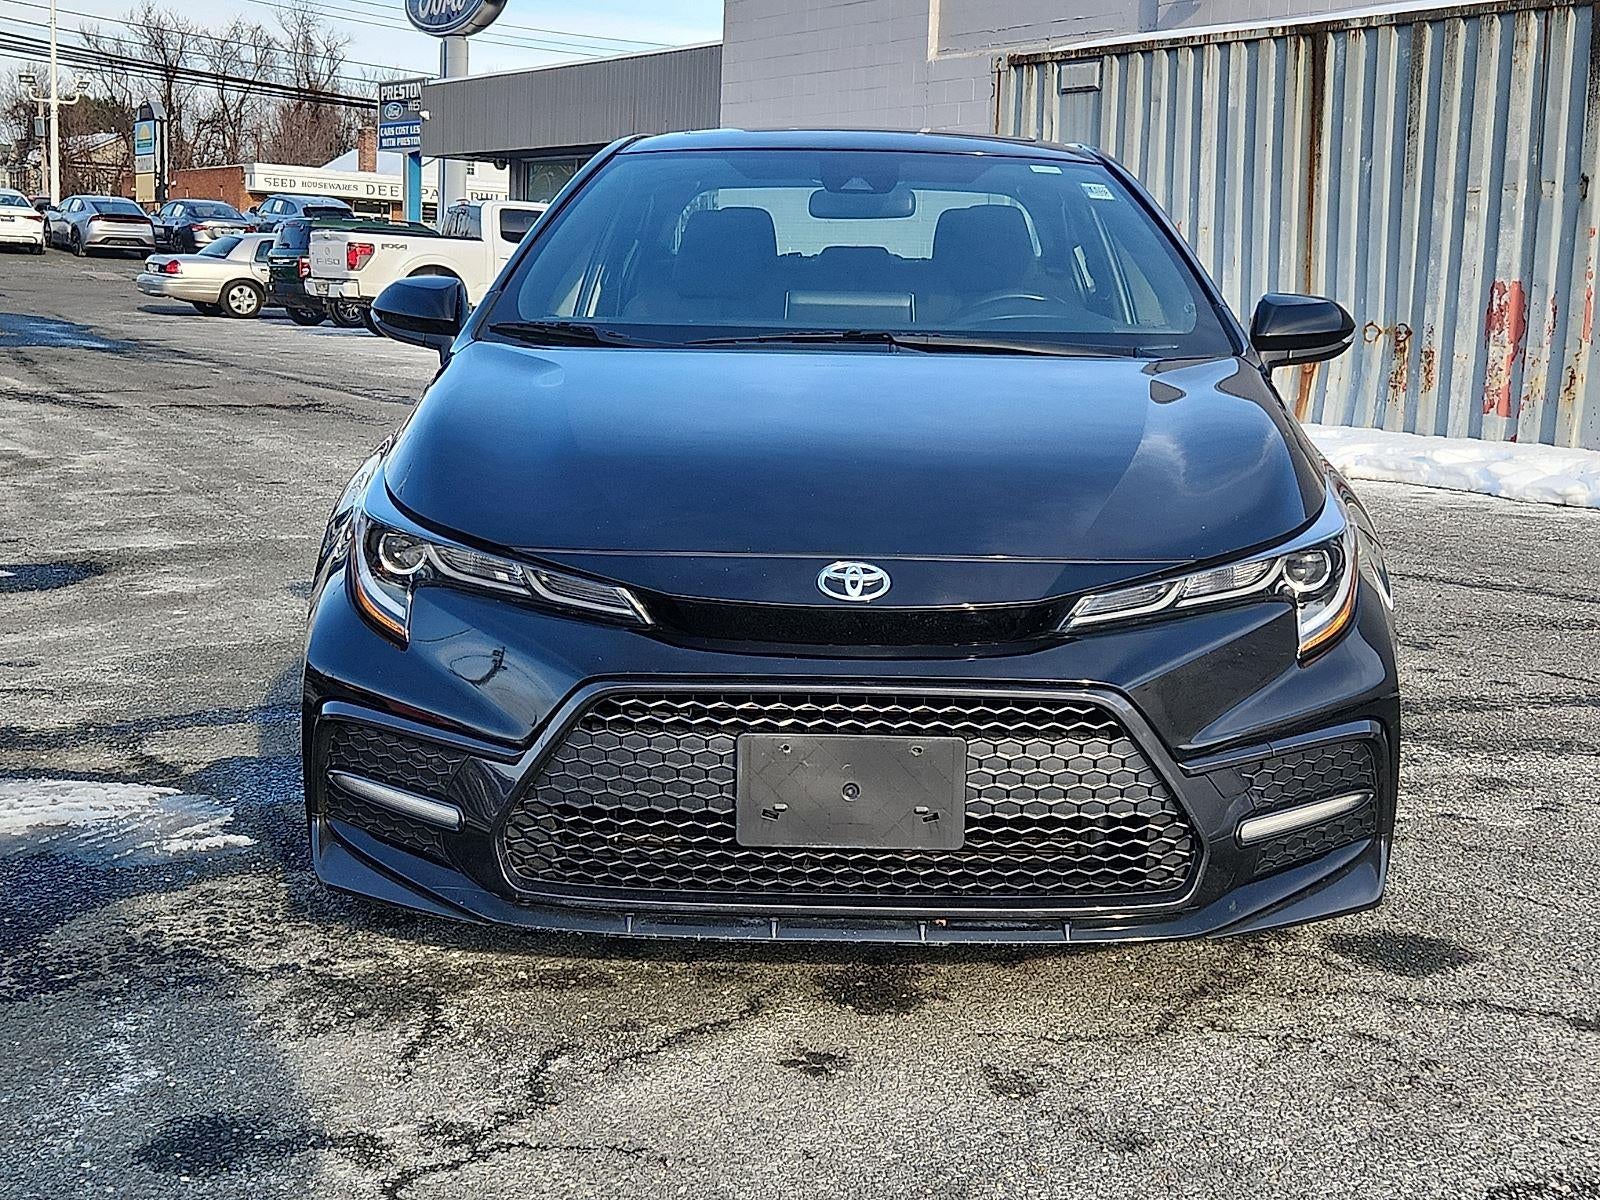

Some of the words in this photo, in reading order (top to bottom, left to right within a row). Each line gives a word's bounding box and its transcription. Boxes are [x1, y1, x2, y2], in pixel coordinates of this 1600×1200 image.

[381, 127, 395, 137] CARS
[396, 125, 410, 135] COST
[382, 138, 396, 147] WITH
[264, 177, 297, 188] SEED
[301, 181, 359, 191] HOUSEWARES
[316, 258, 340, 266] F-150
